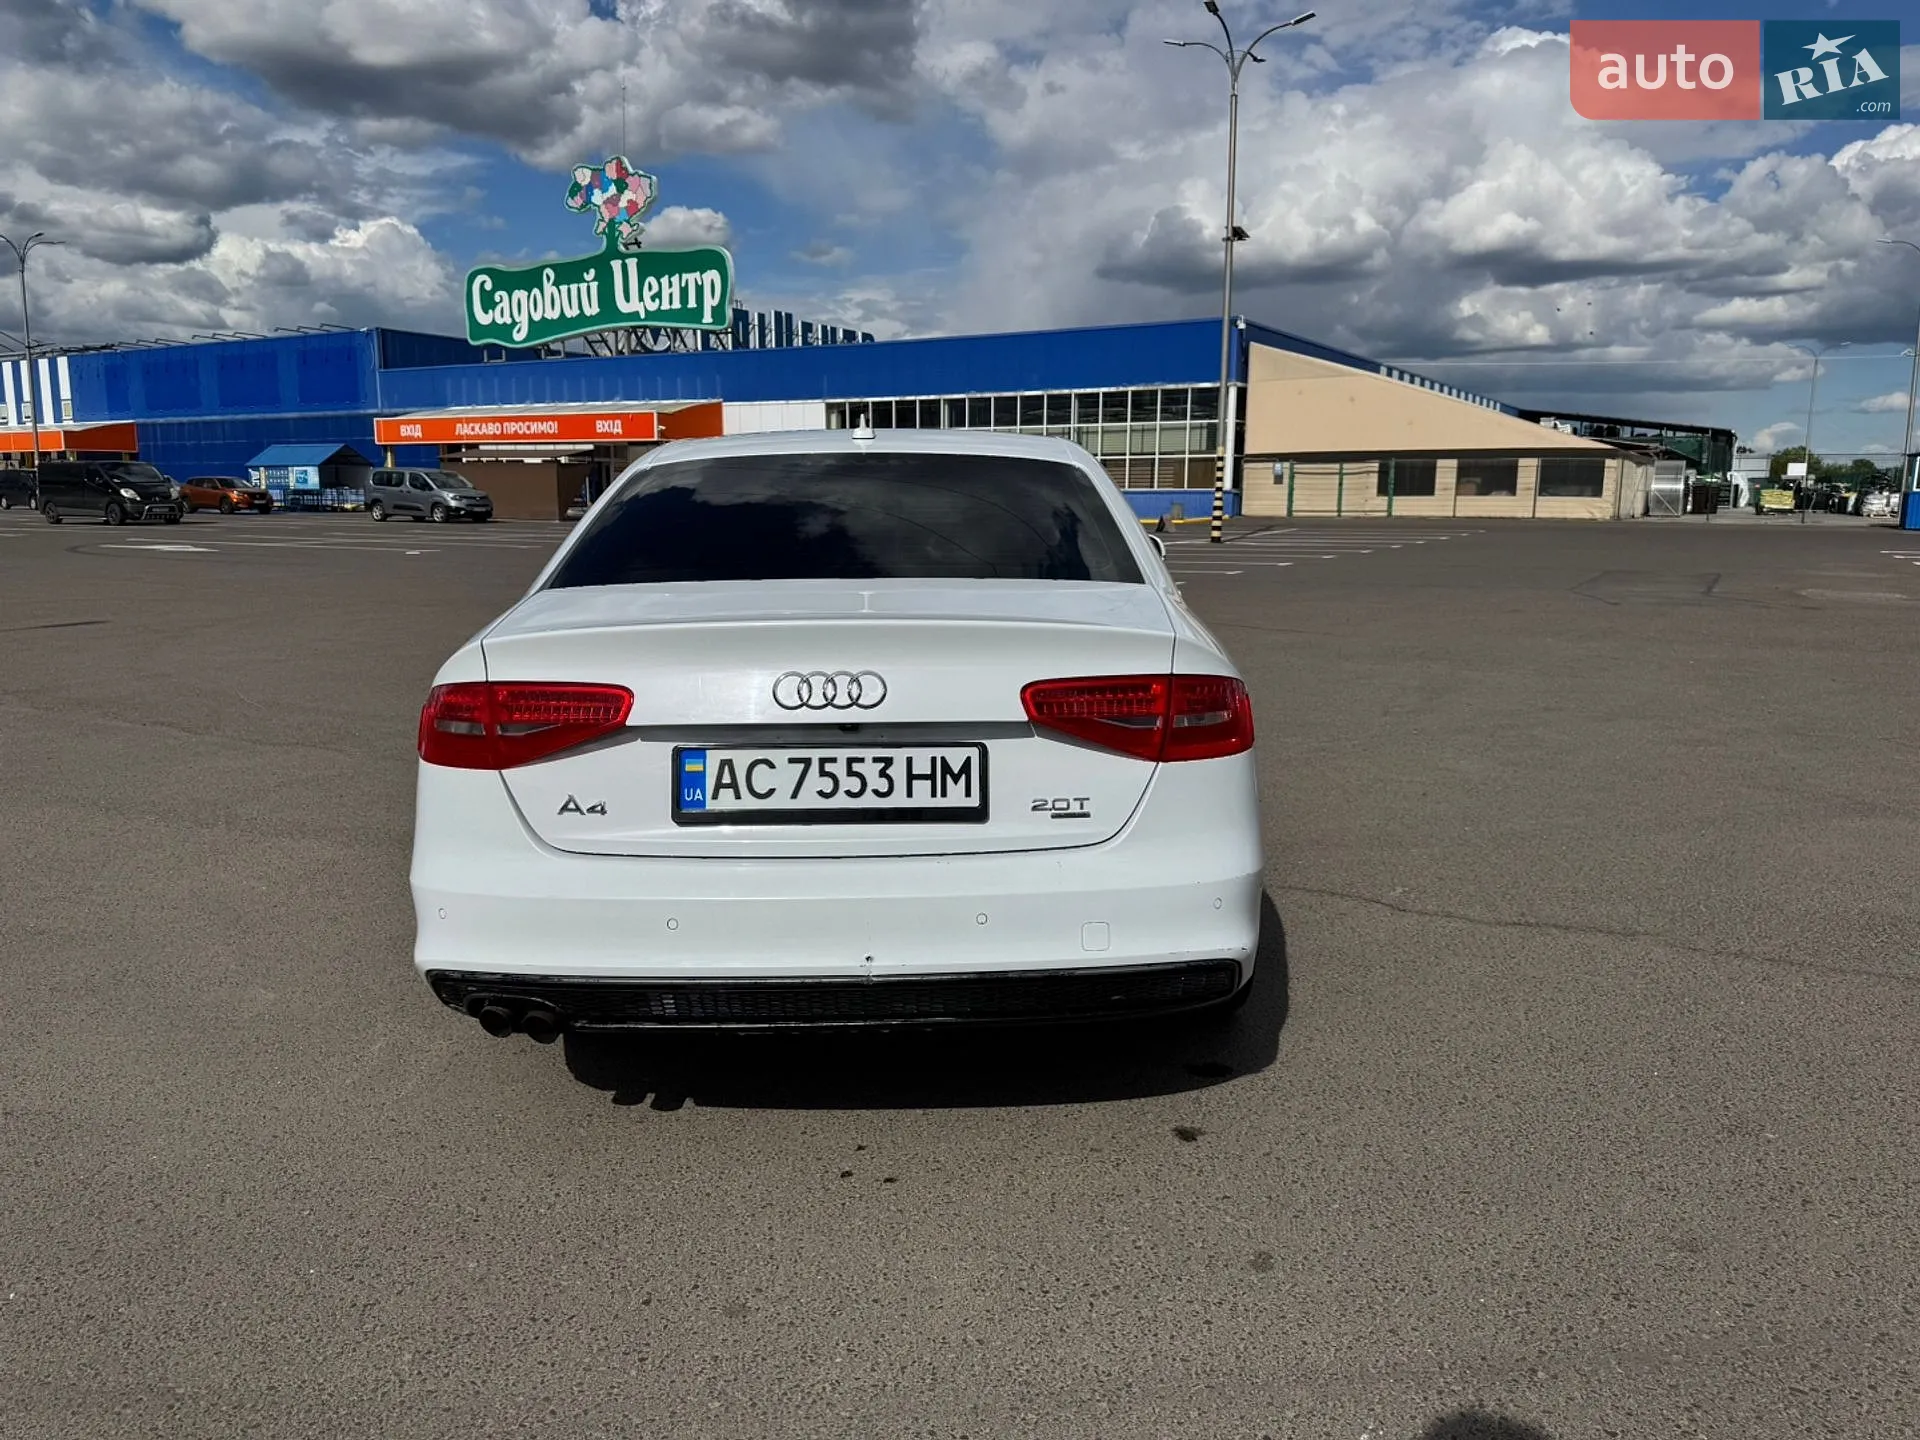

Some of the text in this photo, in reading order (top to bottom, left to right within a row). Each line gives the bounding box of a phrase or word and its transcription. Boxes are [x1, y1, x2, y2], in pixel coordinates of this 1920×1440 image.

[472, 258, 722, 341] Садовий Центр
[400, 424, 423, 438] ВХІД
[455, 420, 559, 436] ЛАСКАВО ПРОСИМО!
[595, 419, 623, 435] ВХІД
[711, 755, 972, 800] AC 7553 HM
[684, 788, 704, 801] UA
[557, 794, 609, 815] A4
